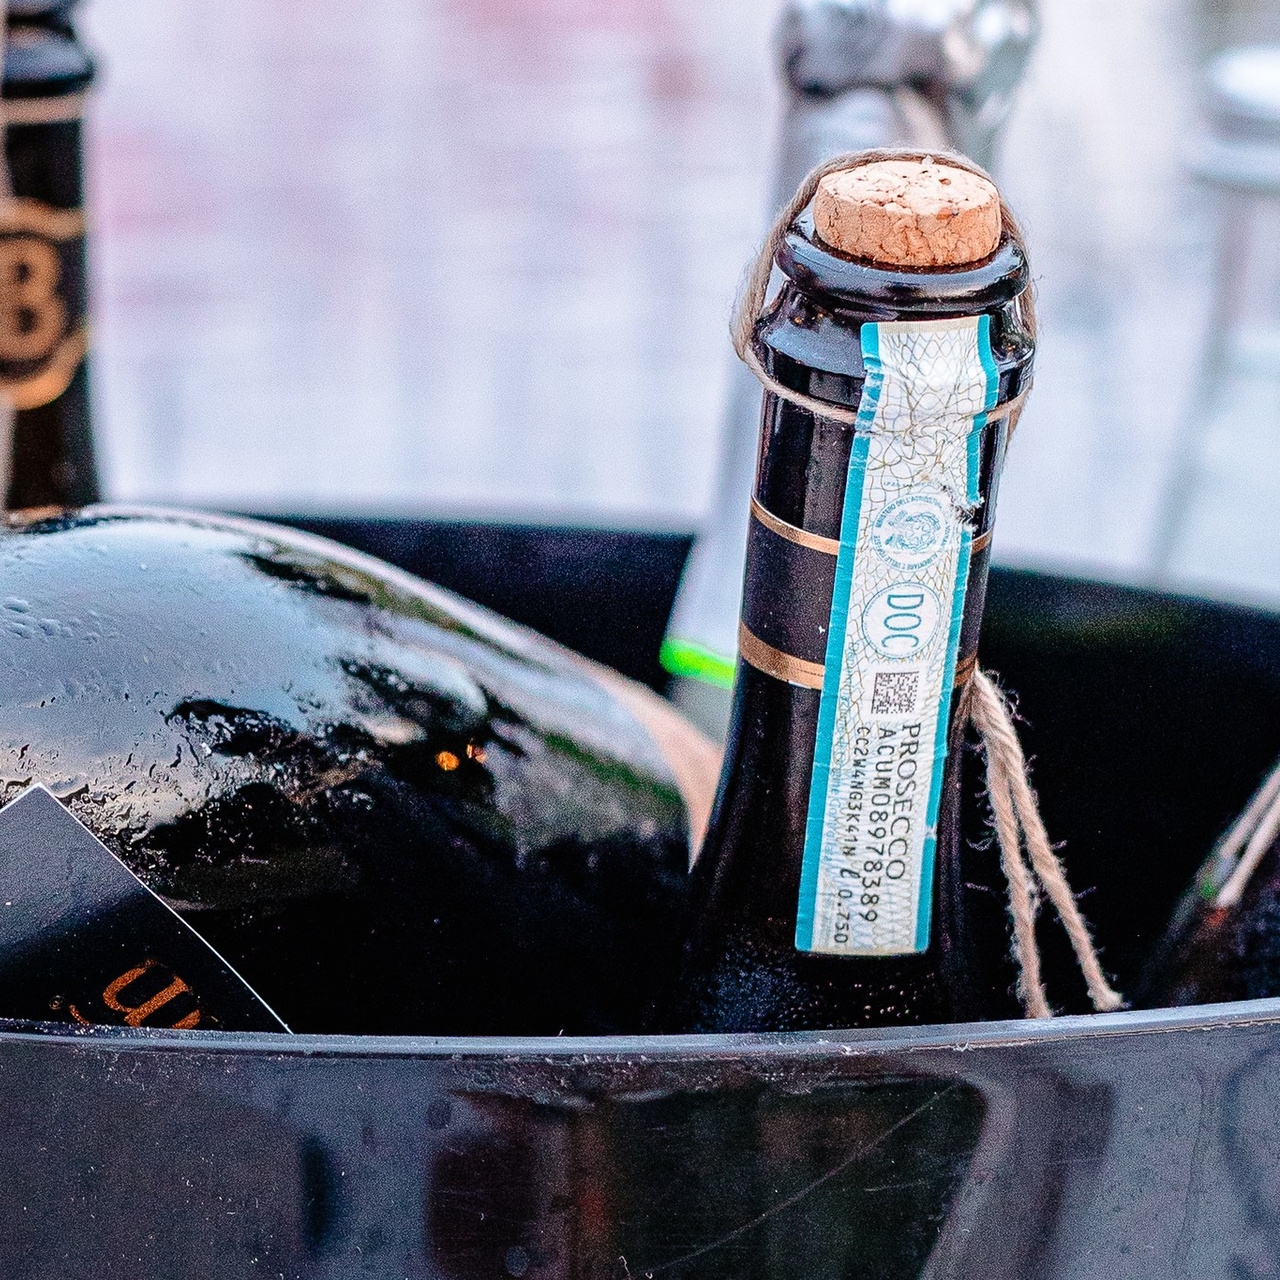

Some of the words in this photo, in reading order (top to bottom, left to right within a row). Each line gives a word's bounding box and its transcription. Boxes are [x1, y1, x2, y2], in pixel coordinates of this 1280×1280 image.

[881, 593, 925, 648] DOC
[885, 722, 921, 880] PROSECCO
[833, 888, 854, 944] 0.750
